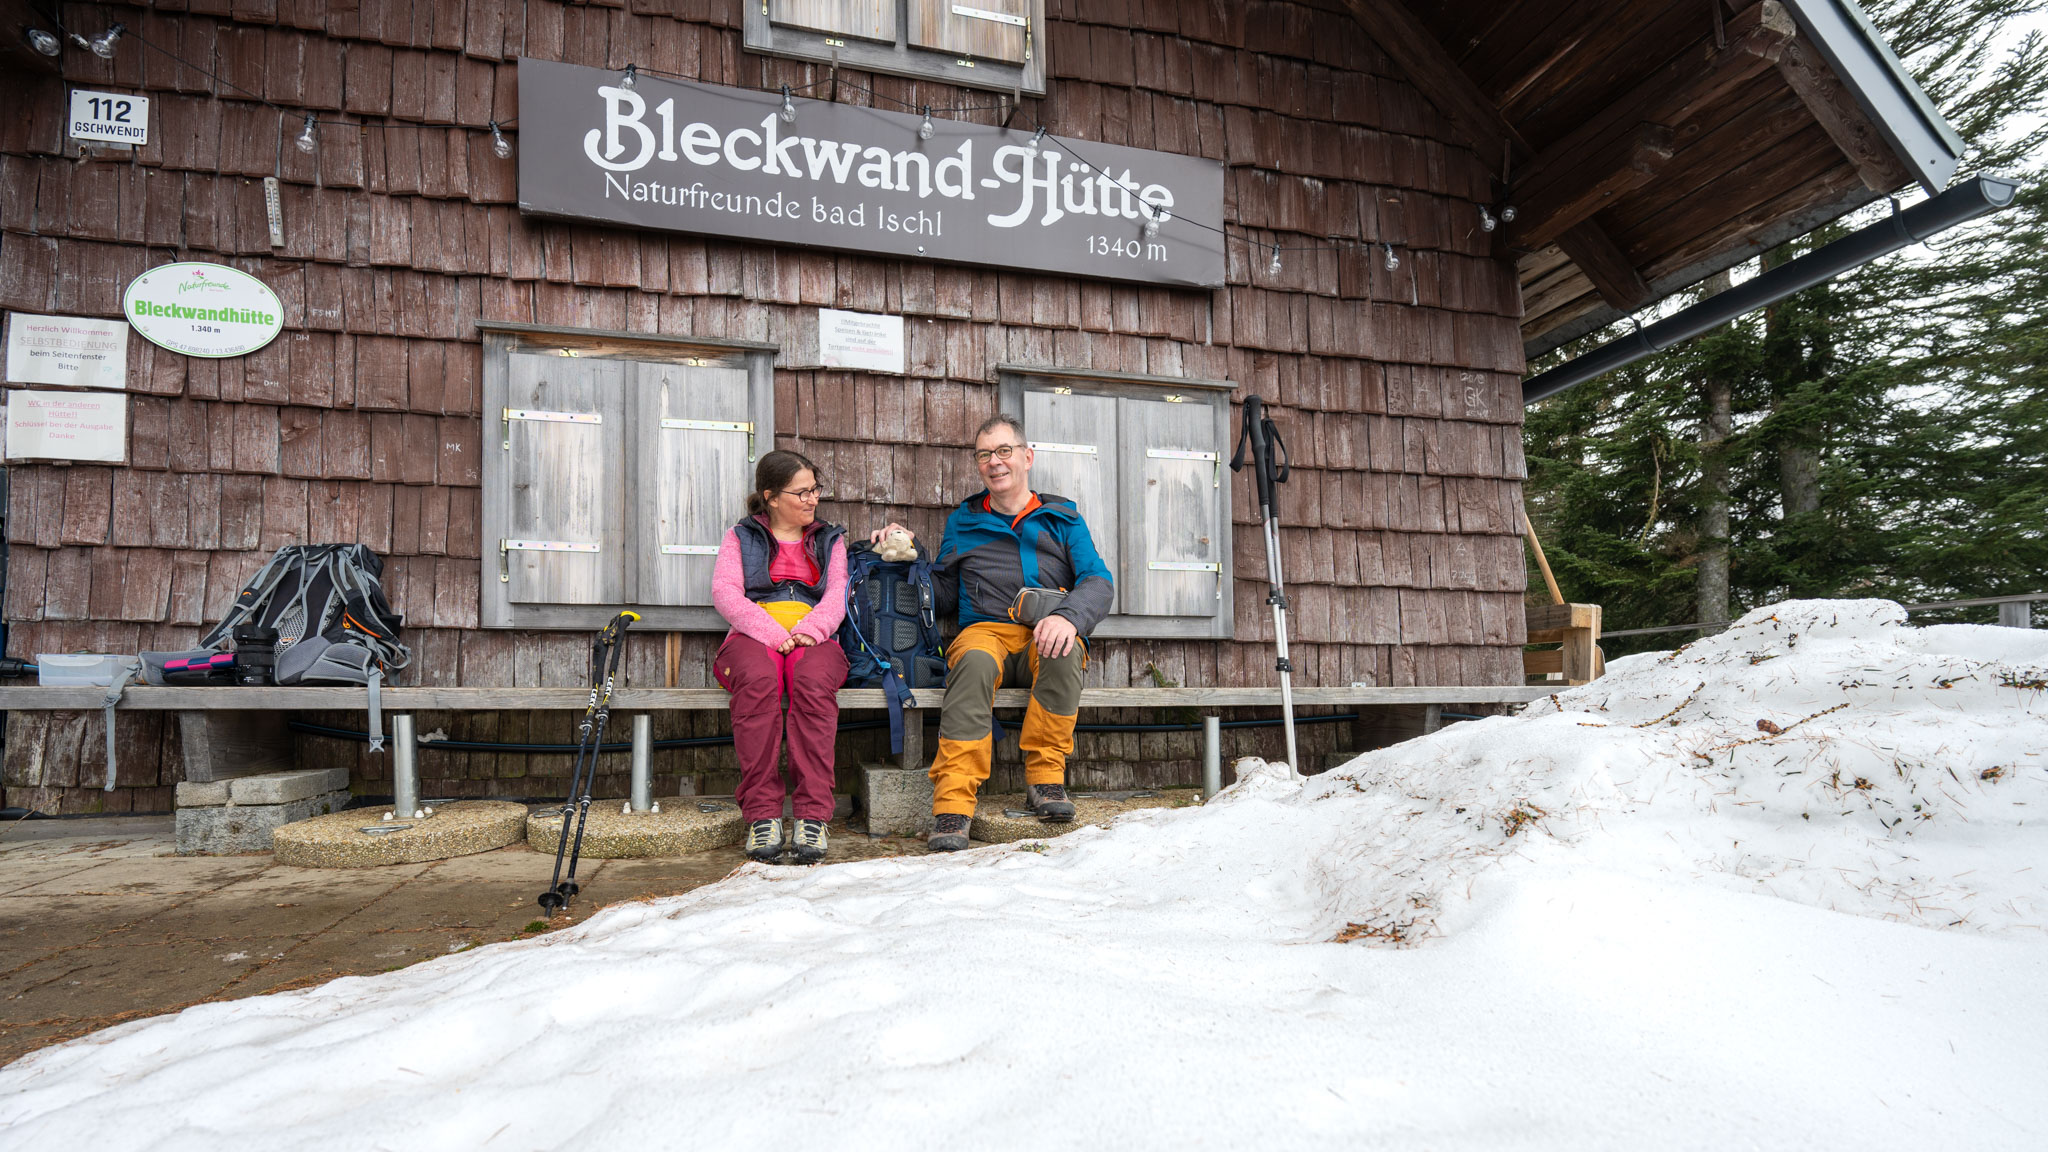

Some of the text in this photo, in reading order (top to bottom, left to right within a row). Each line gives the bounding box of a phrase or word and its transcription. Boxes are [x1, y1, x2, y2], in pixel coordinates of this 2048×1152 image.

[88, 97, 132, 123] 112
[75, 121, 145, 138] GSCHWENDT
[583, 86, 1175, 228] Bleckwand-Hütte
[604, 171, 801, 219] Naturfreunde
[878, 205, 942, 237] Ischl
[1086, 235, 1168, 262] 1340 m
[178, 278, 232, 295] Naturfreunde
[135, 299, 275, 326] Bleckwandhütte
[26, 324, 113, 337] Herzlich Willkommen
[191, 325, 212, 333] 1.340
[20, 336, 118, 350] SELBSTBEDIENUNG
[165, 339, 179, 349] GPS
[30, 349, 107, 361] beim Seitenfenster
[58, 363, 79, 371] Bitte
[1463, 386, 1487, 409] GK
[28, 400, 41, 408] WC
[52, 400, 65, 408] der
[67, 401, 101, 410] anderen
[15, 420, 48, 428] Schlüssel
[79, 423, 113, 431] Ausgabe
[49, 432, 76, 440] Danke
[446, 442, 462, 453] MK
